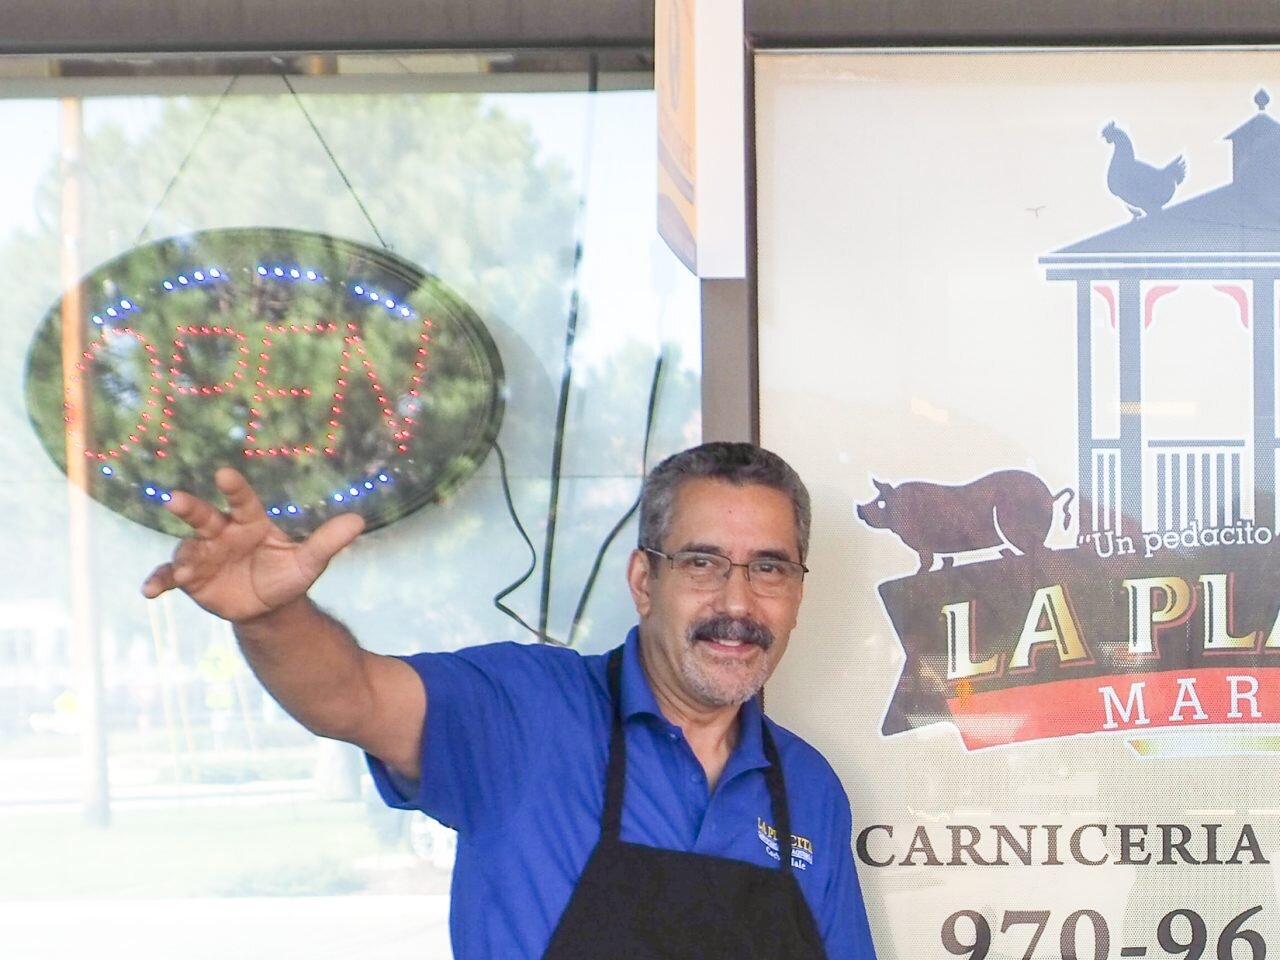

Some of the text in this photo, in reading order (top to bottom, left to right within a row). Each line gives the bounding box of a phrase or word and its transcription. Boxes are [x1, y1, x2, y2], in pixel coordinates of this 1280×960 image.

[65, 320, 433, 458] OPEN
[1144, 520, 1272, 559] pedacito
[941, 584, 1094, 682] LA
[855, 822, 1269, 868] CARNICERIA
